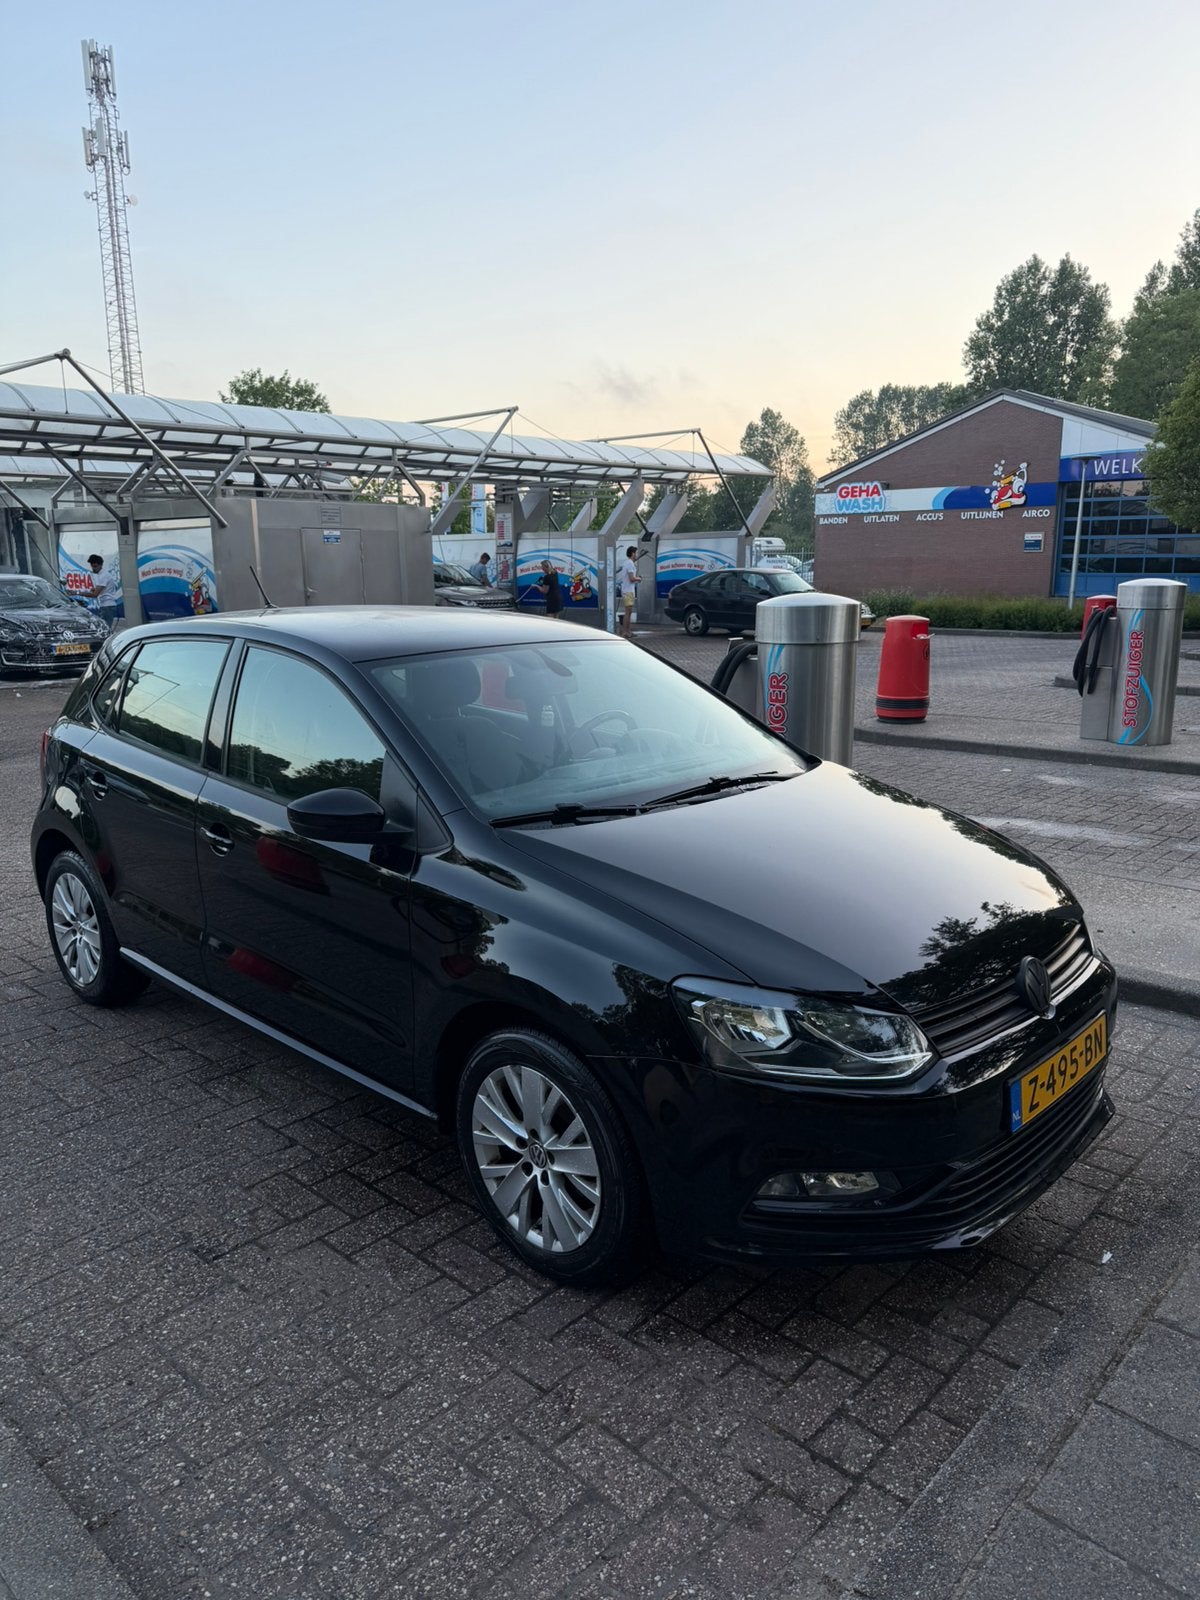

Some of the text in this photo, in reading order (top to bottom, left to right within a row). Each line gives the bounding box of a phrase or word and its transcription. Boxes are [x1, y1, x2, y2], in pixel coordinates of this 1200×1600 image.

[1094, 458, 1143, 475] WELK
[838, 484, 881, 499] GEHA
[836, 497, 883, 511] WASH
[819, 509, 1051, 525] BANDEN UITLATEN ACCU'S UITLIJNEN AIRCO
[66, 573, 94, 590] GEHA
[1123, 631, 1144, 727] STOFZUIGER
[768, 673, 788, 737] IGER
[1028, 1023, 1103, 1114] Z-495-BN
[1012, 1110, 1021, 1122] NL
